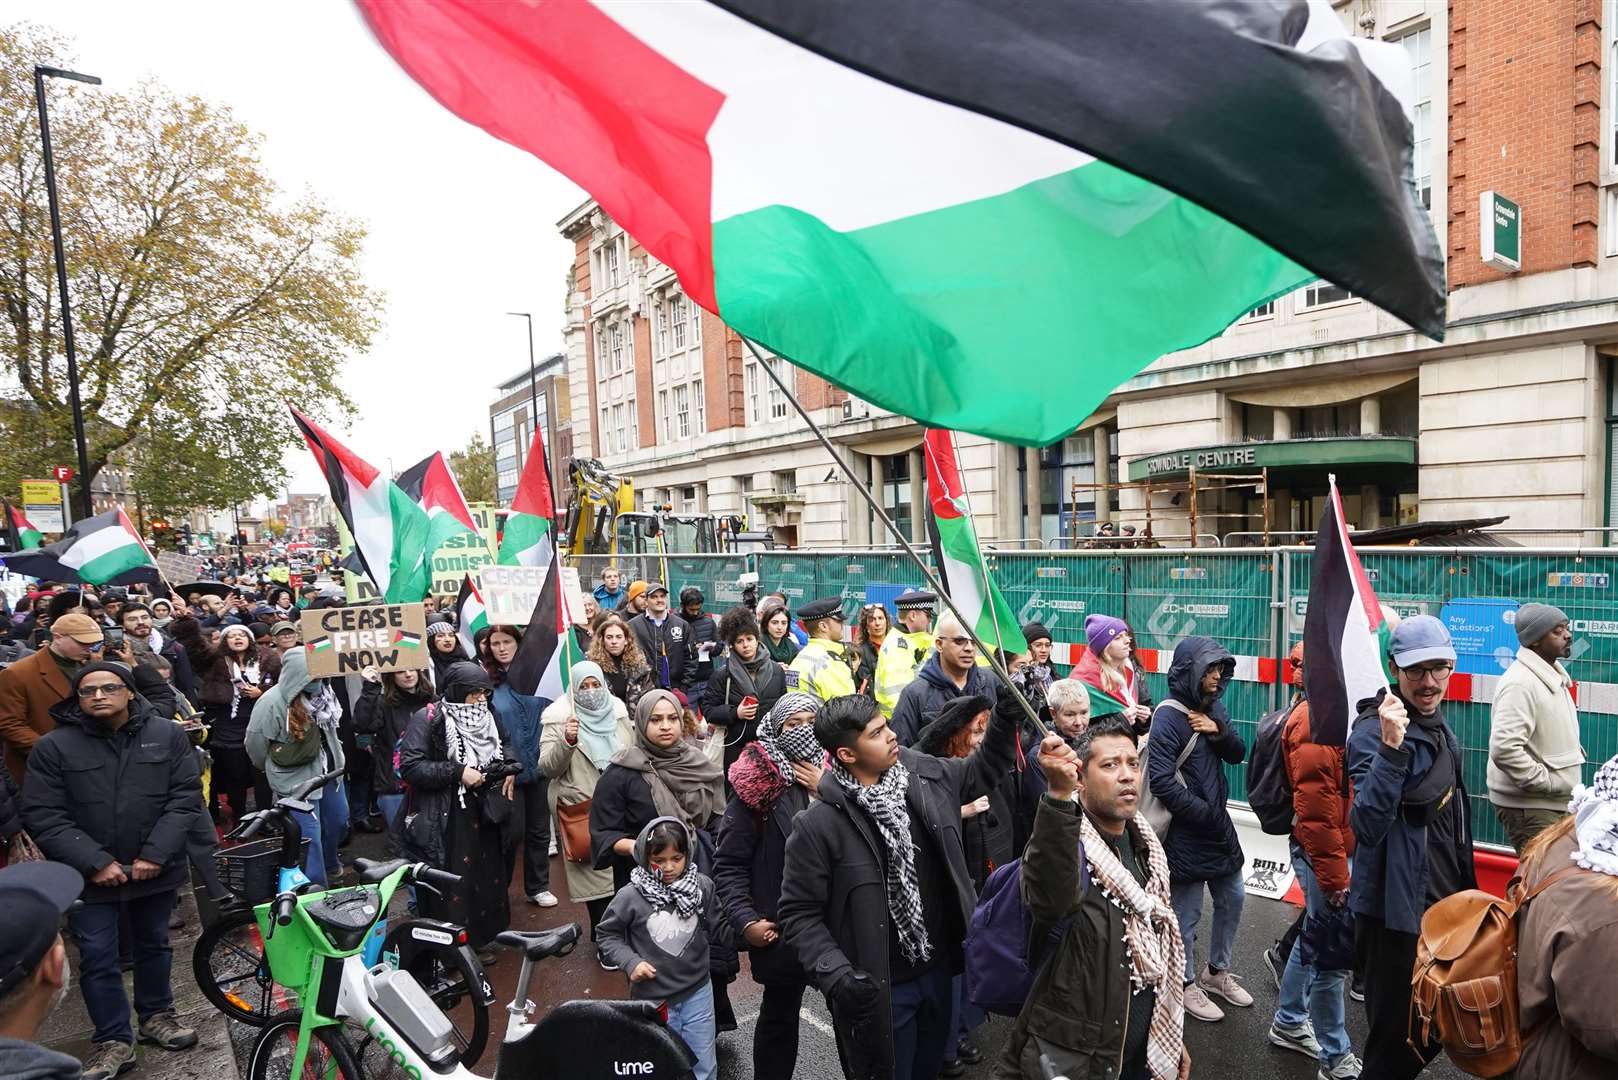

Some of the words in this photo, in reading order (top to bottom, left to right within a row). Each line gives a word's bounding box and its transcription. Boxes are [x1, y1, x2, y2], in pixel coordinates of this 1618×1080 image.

[1197, 448, 1255, 467] CENTRE
[58, 468, 67, 478] F
[321, 606, 402, 632] CEASE
[1449, 615, 1465, 625] Any
[334, 629, 390, 652] FIRE
[338, 649, 399, 672] NOW
[1252, 858, 1291, 875] BULL
[614, 1061, 654, 1075] Lime
